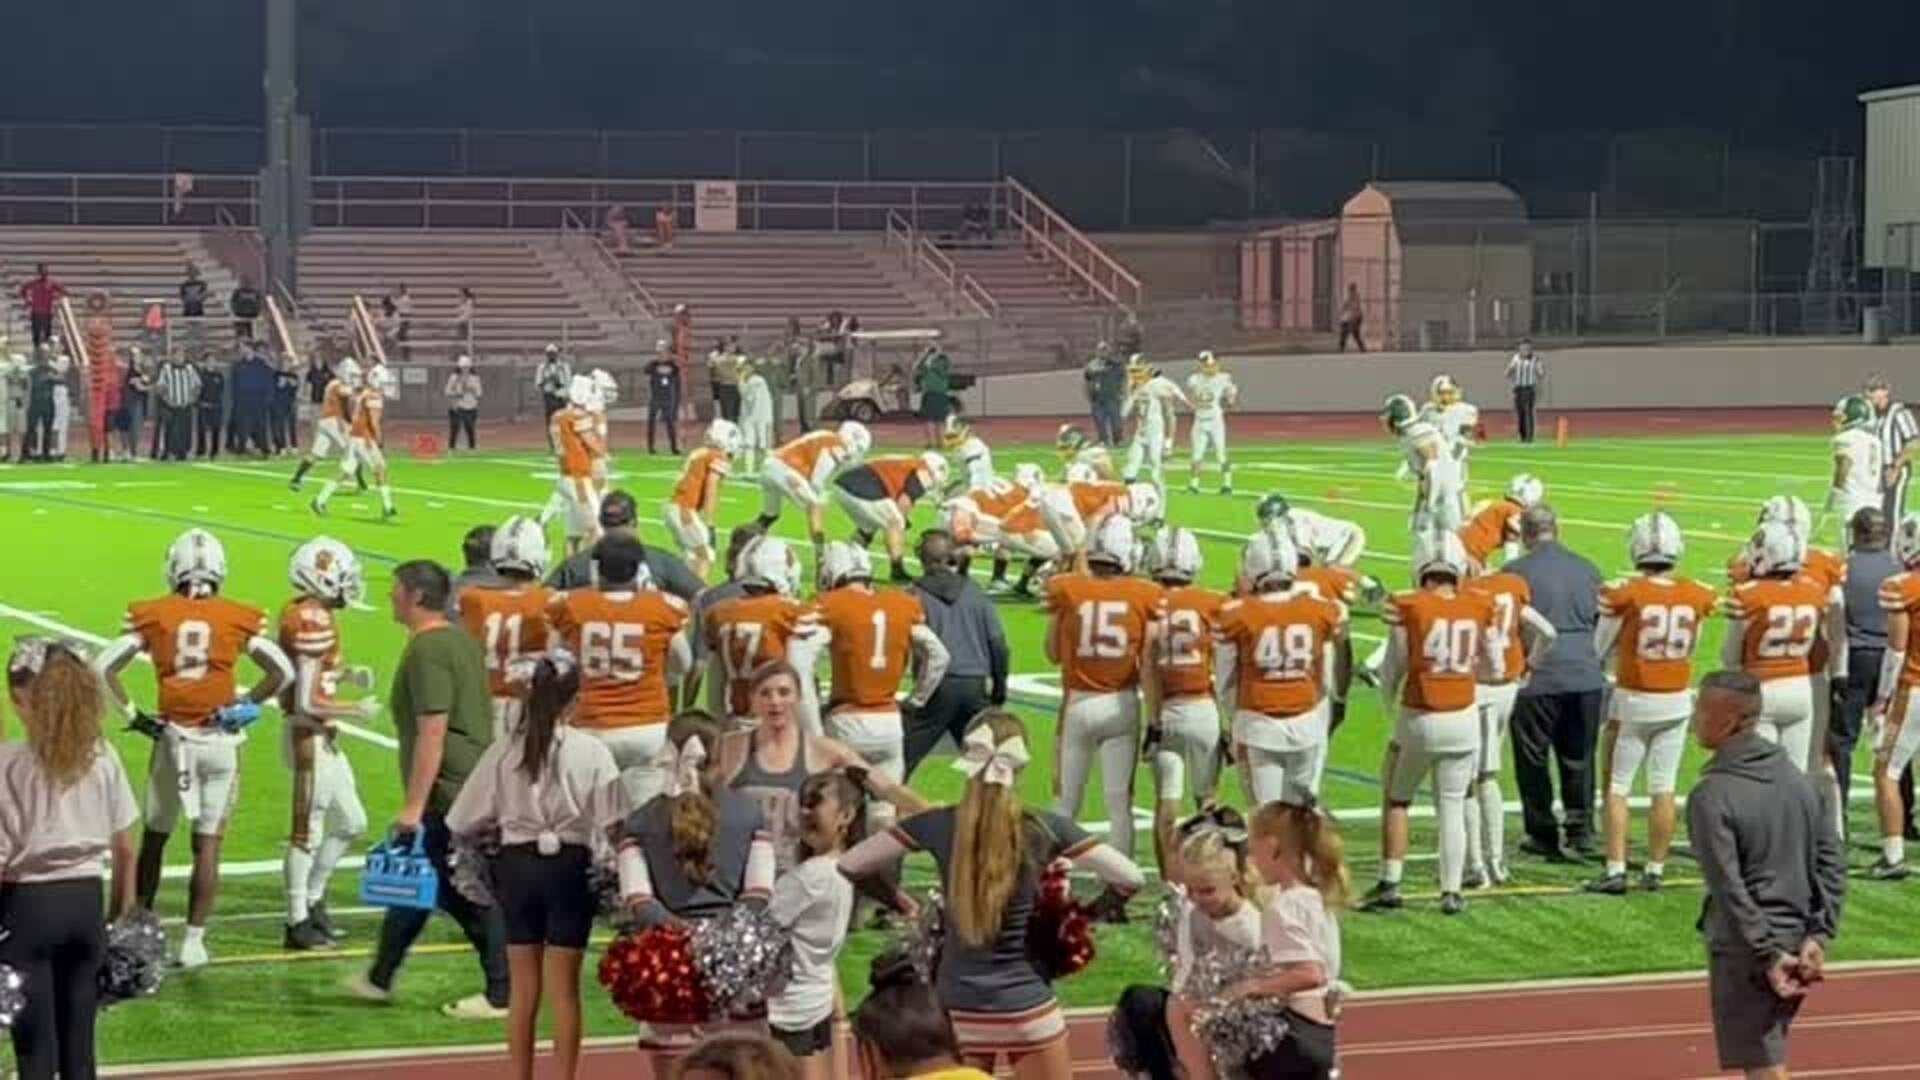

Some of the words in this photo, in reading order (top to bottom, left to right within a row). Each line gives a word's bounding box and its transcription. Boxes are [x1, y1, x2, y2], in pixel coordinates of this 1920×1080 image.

[174, 619, 211, 681] 8
[483, 611, 523, 673] 11
[580, 621, 646, 682] 65
[868, 608, 888, 670] 1
[1075, 599, 1130, 659] 15
[1254, 622, 1314, 681] 48
[1423, 618, 1478, 674] 40
[1636, 604, 1697, 662] 26
